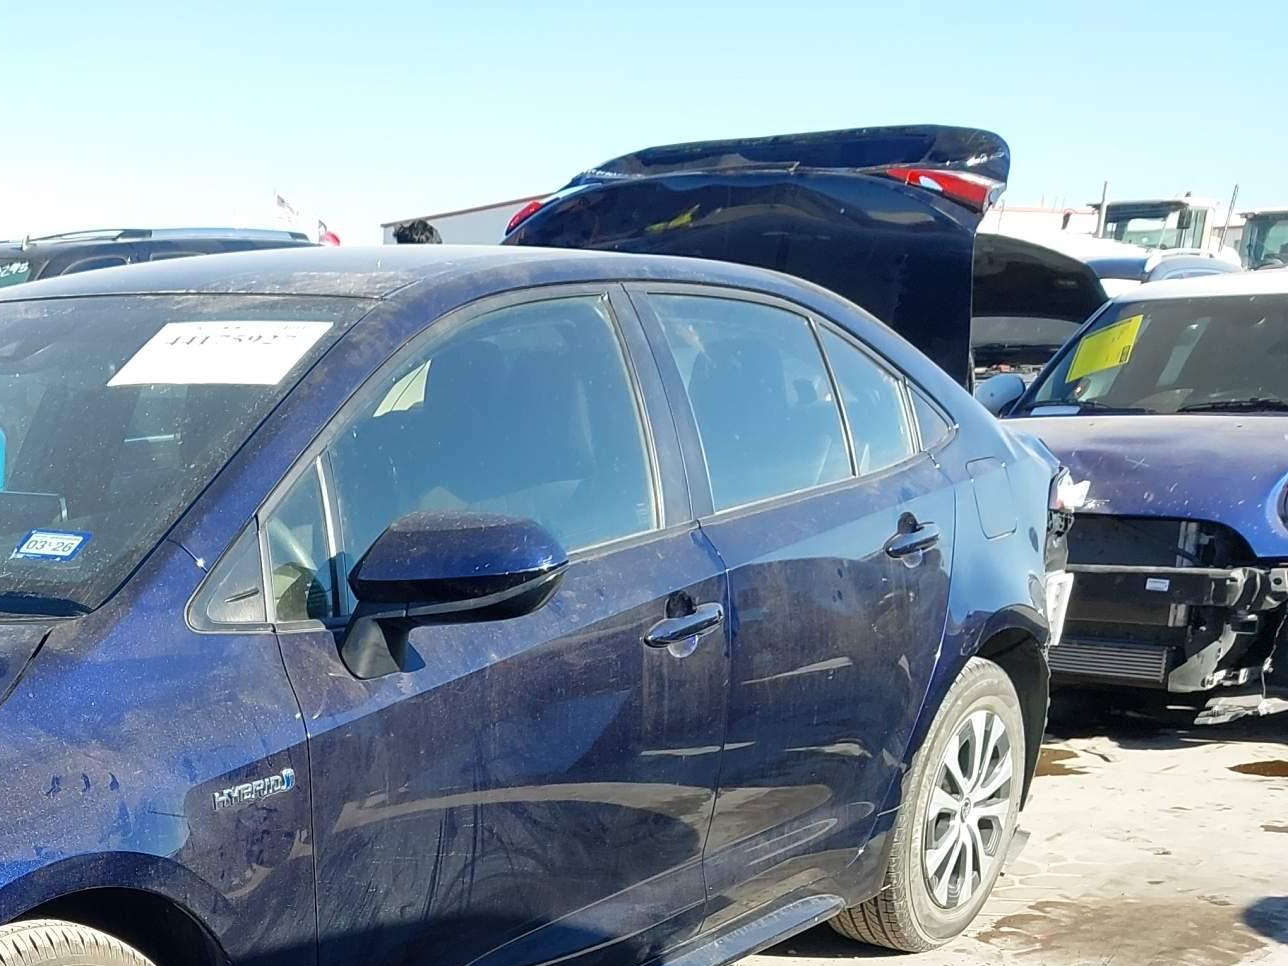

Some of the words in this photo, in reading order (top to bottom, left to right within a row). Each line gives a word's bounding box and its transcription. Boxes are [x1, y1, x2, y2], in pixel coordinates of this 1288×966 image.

[26, 540, 47, 550] 03
[50, 541, 74, 552] 26
[212, 775, 282, 811] HYBRID
